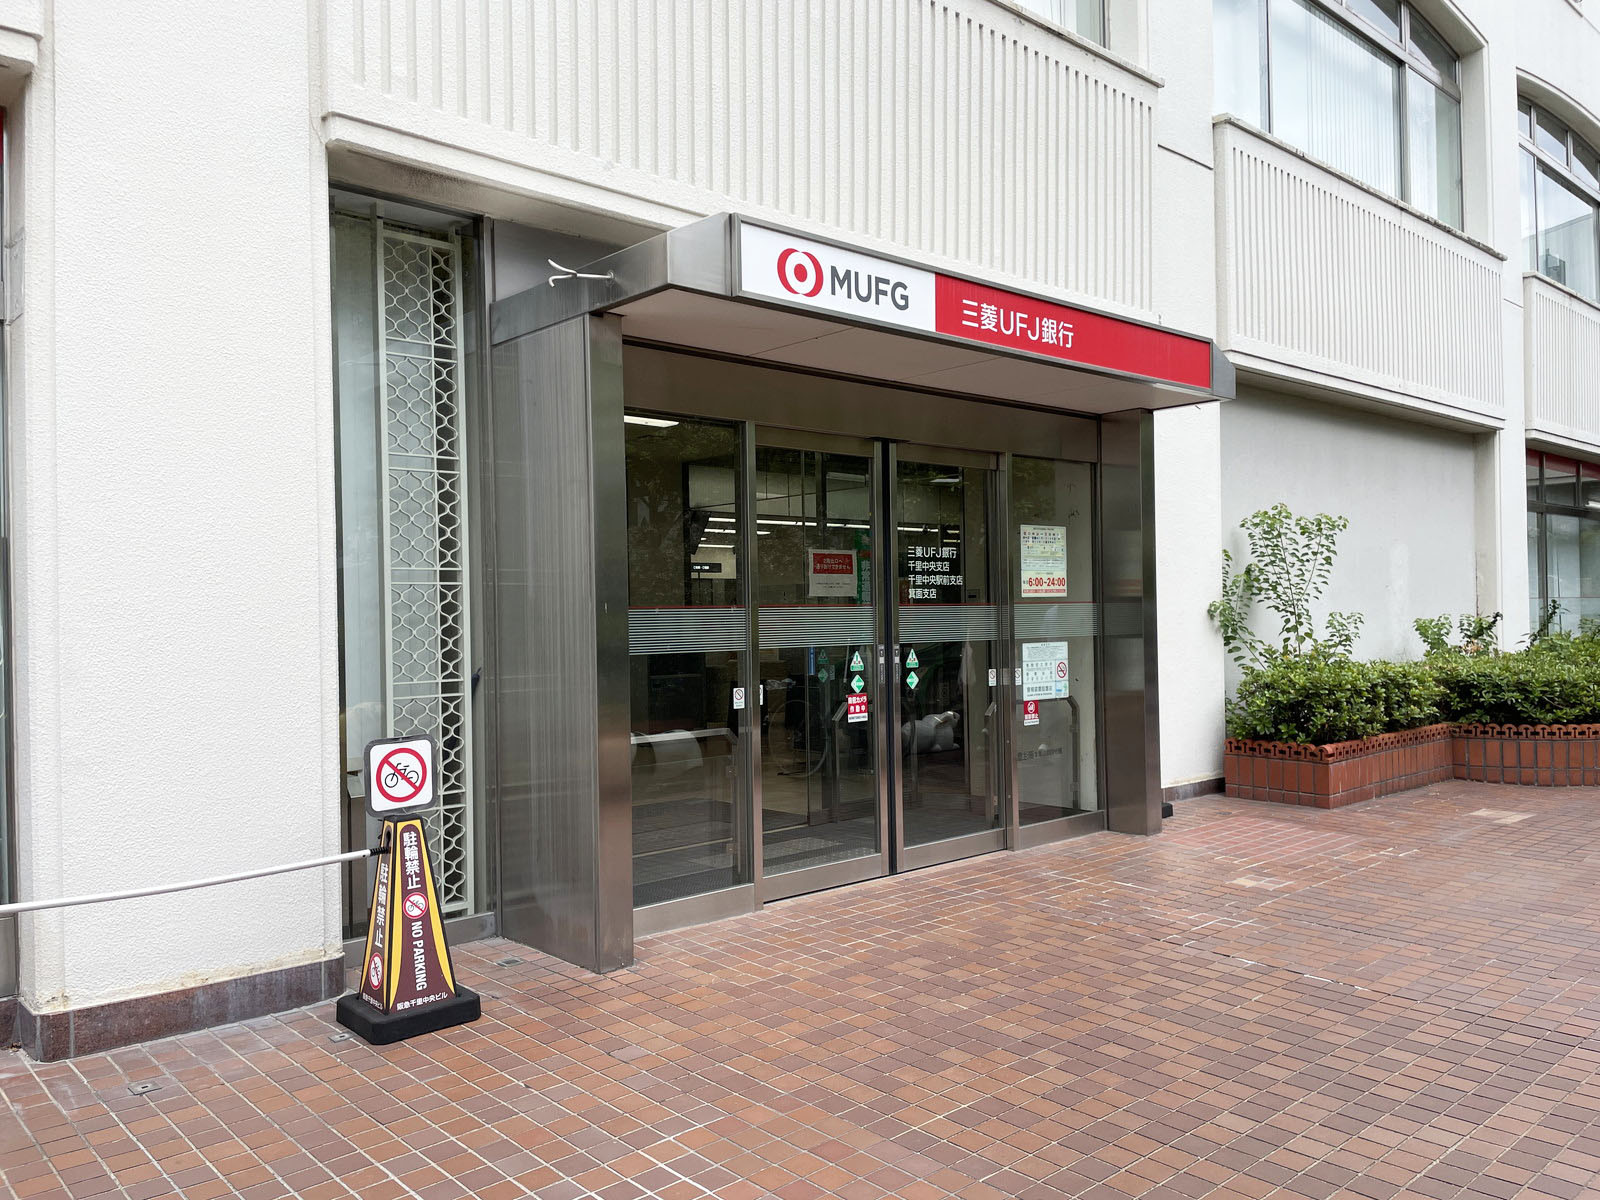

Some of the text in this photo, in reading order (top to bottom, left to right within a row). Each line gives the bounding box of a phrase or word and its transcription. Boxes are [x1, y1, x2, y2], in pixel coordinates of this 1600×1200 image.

[830, 266, 909, 312] MUFG
[961, 299, 1074, 349] 三菱UFJ銀行
[907, 546, 957, 559] 三菱UFJ銀行
[907, 560, 950, 572] 千里中央支店
[908, 574, 963, 586] 千里中央駅前支店
[908, 588, 937, 599] 箕面支店
[403, 831, 421, 890] 駐輪禁止
[374, 862, 389, 949] 駐輪禁止
[411, 921, 428, 991] NO PARKING
[396, 991, 448, 1011] 阪急千里中央ビル
